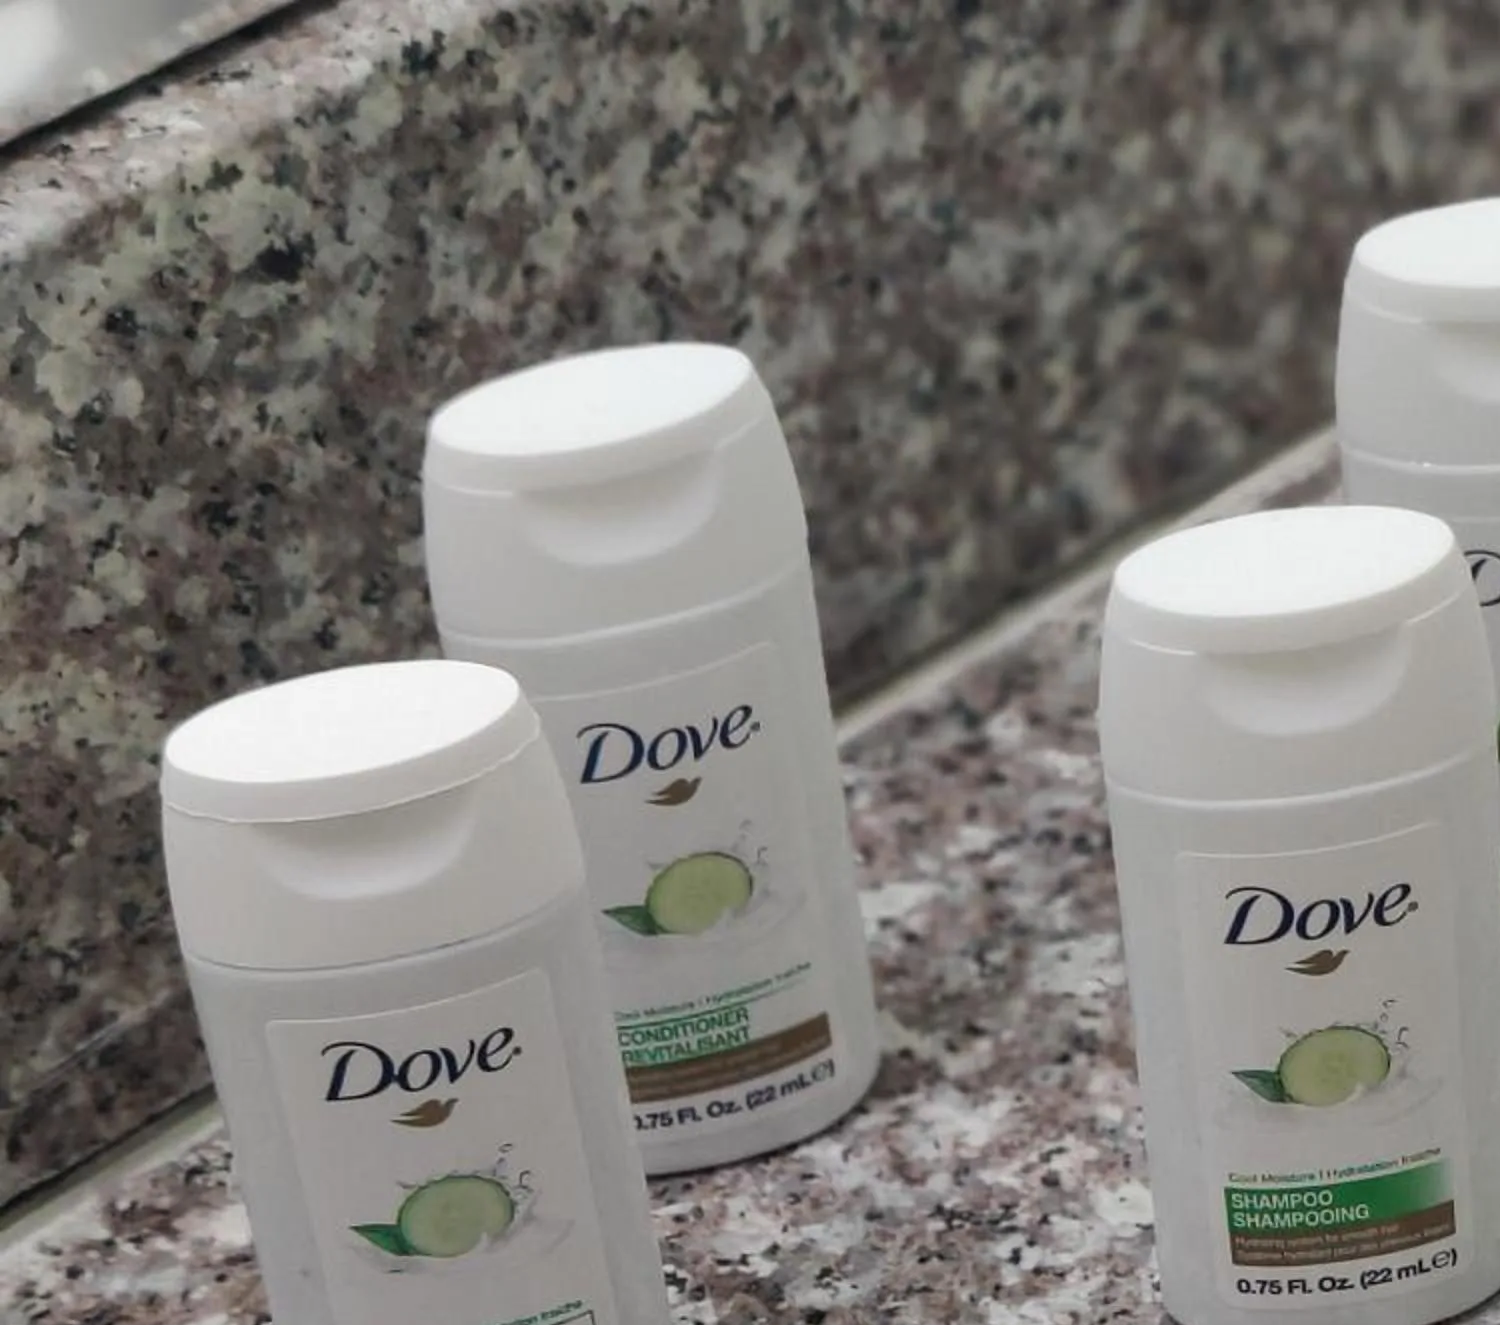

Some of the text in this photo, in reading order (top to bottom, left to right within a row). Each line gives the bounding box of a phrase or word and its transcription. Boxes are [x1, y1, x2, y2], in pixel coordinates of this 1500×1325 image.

[576, 705, 758, 784] Dove
[1224, 884, 1417, 945] Dove
[618, 1006, 750, 1047] CONDITIONER
[321, 1027, 520, 1102] Dove
[707, 1100, 742, 1118] Oz.
[1231, 1190, 1333, 1210] SHAMPOO
[1233, 1204, 1370, 1229] SHAMPOOING
[1237, 1279, 1282, 1295] 0.75
[1288, 1280, 1312, 1294] Fl.
[1318, 1276, 1353, 1293] Oz.
[1360, 1268, 1393, 1290] (22
